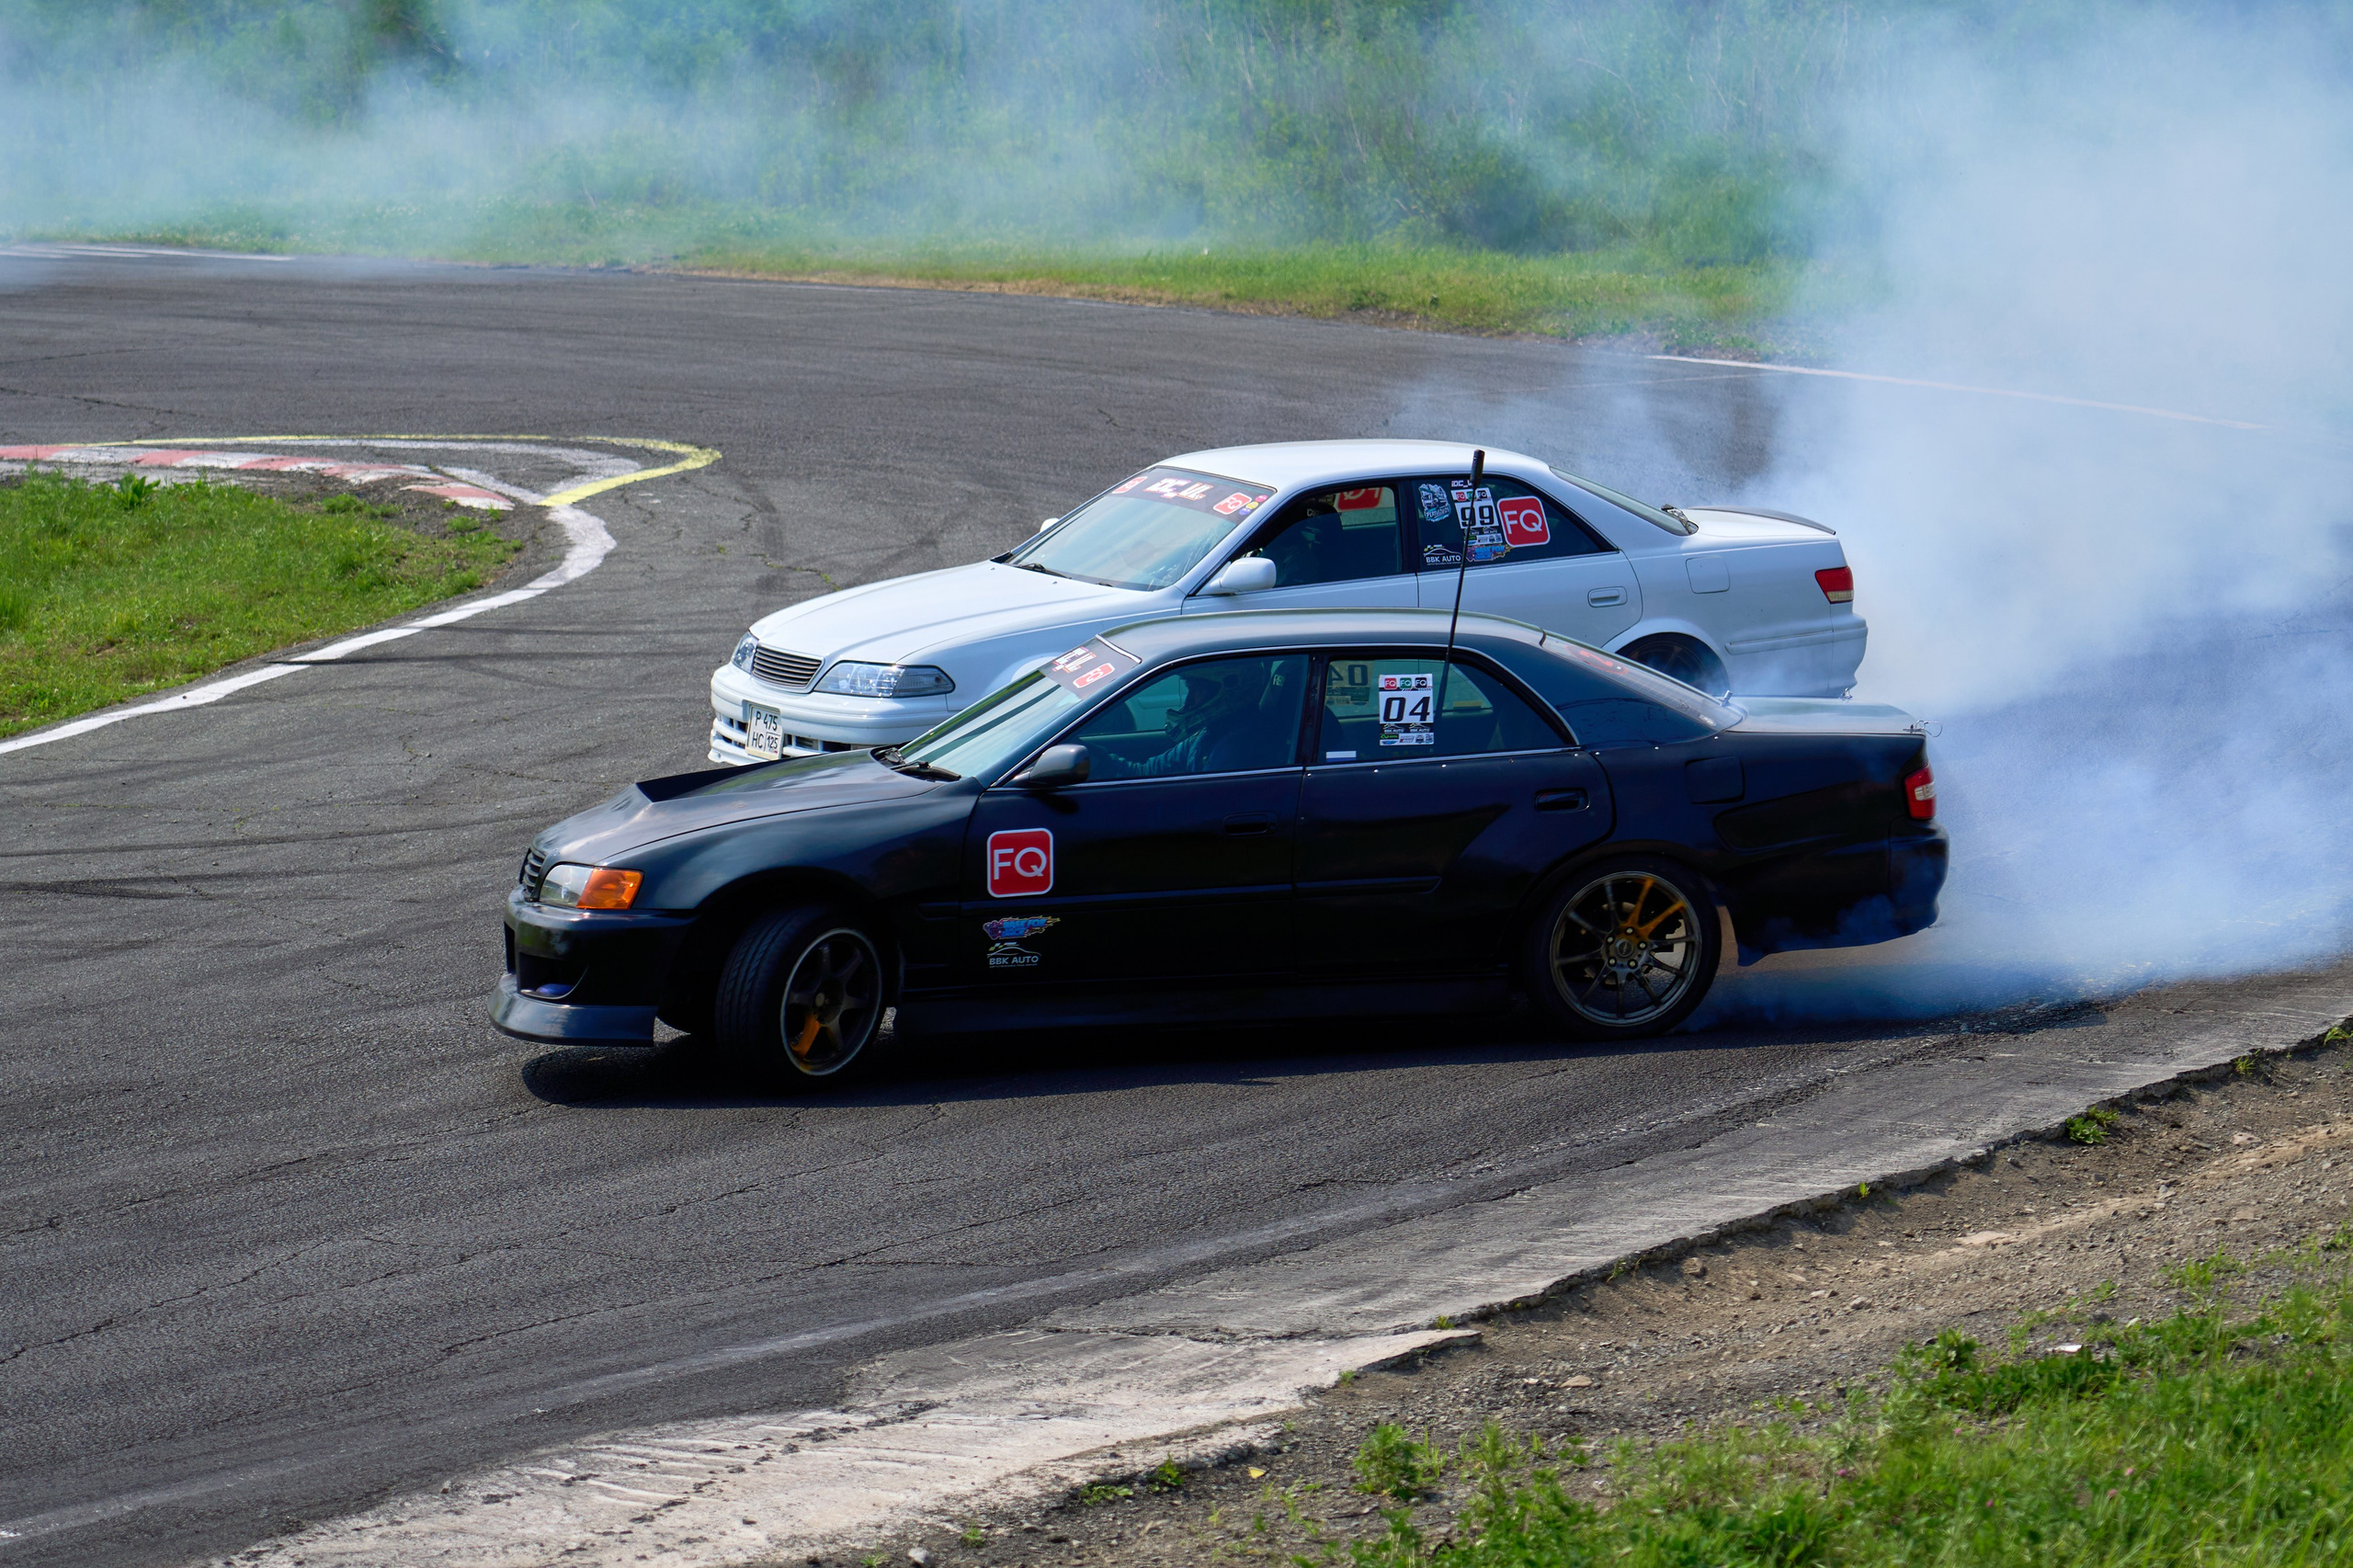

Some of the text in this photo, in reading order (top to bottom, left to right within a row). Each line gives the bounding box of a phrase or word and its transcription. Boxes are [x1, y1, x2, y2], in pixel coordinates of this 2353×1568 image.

[1461, 506, 1495, 528] 99
[1503, 509, 1542, 534] FQ
[1383, 697, 1430, 722] 04
[764, 713, 778, 731] 475
[767, 736, 778, 749] 125
[993, 846, 1047, 881] FQ
[989, 955, 1040, 965] BBK AUTO
